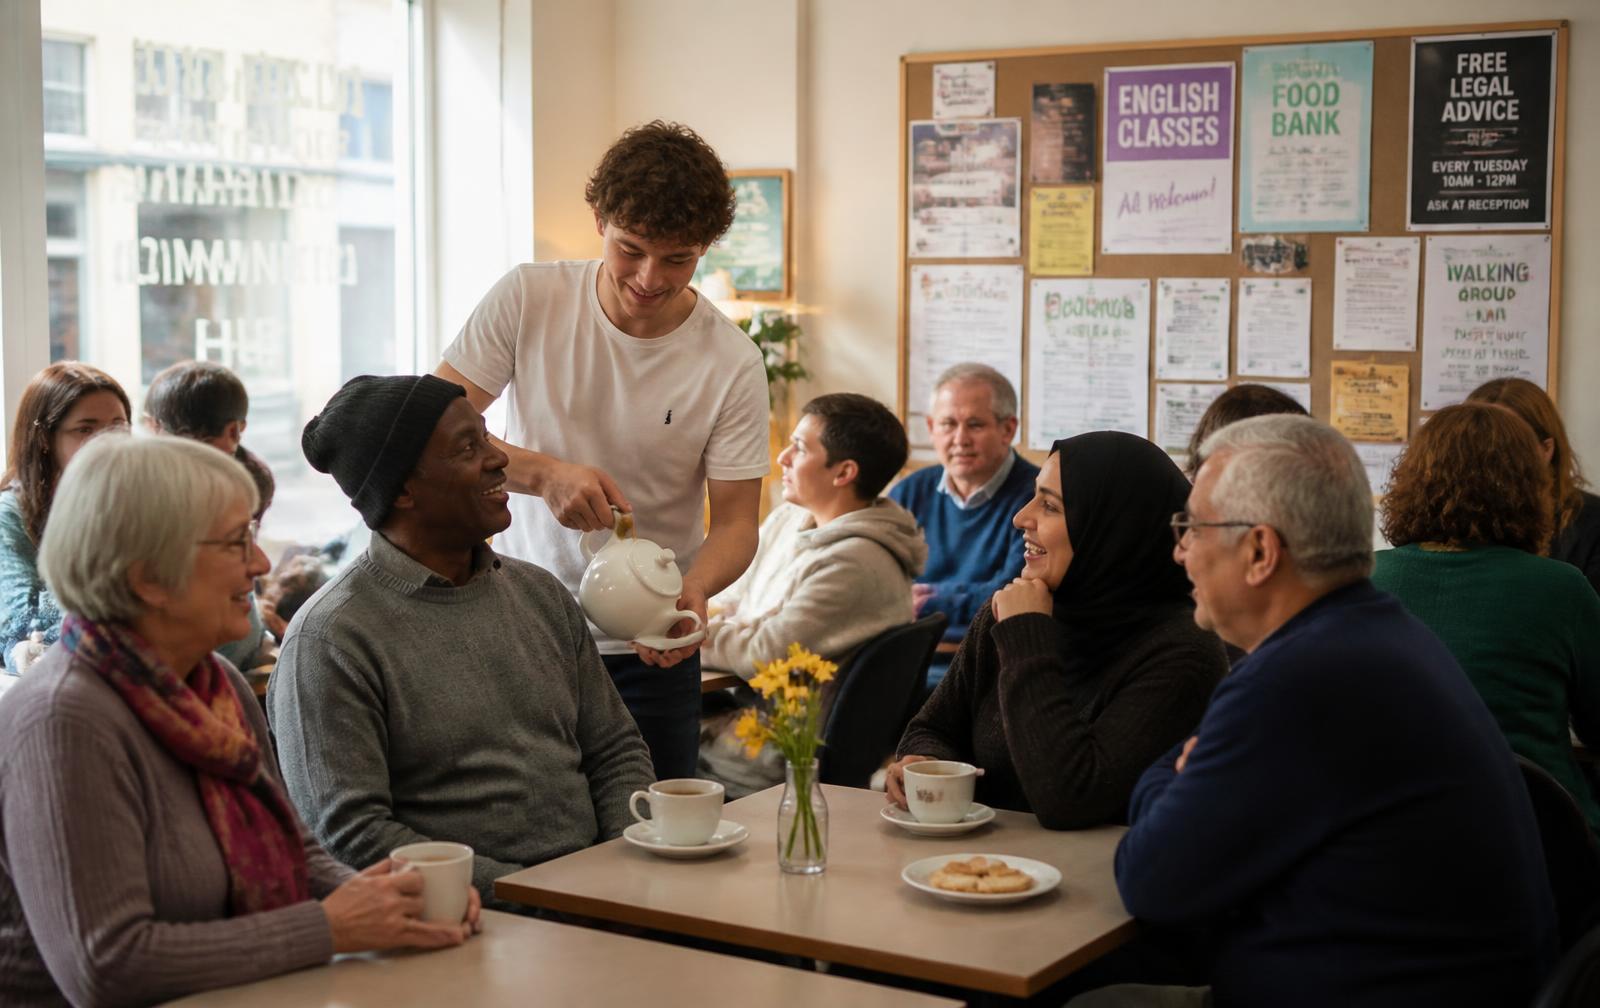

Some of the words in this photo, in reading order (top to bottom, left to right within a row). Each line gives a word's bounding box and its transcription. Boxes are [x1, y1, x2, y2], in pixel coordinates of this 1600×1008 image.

[1457, 52, 1507, 74] FREE
[1272, 82, 1341, 108] FOOD
[1450, 76, 1514, 98] LEGAL
[1119, 82, 1219, 115] ENGLISH
[1441, 99, 1519, 122] ADVICE
[1118, 116, 1219, 148] CLASSES
[1272, 110, 1341, 137] BANK
[1432, 160, 1470, 173] EVERY
[1473, 158, 1529, 172] TUESDAY
[1442, 175, 1474, 187] 10AM
[1485, 174, 1517, 187] 12PM
[1427, 200, 1449, 211] ASK
[1452, 200, 1466, 210] AT
[1468, 198, 1530, 210] RECEPTION
[1447, 262, 1529, 282] WALKING
